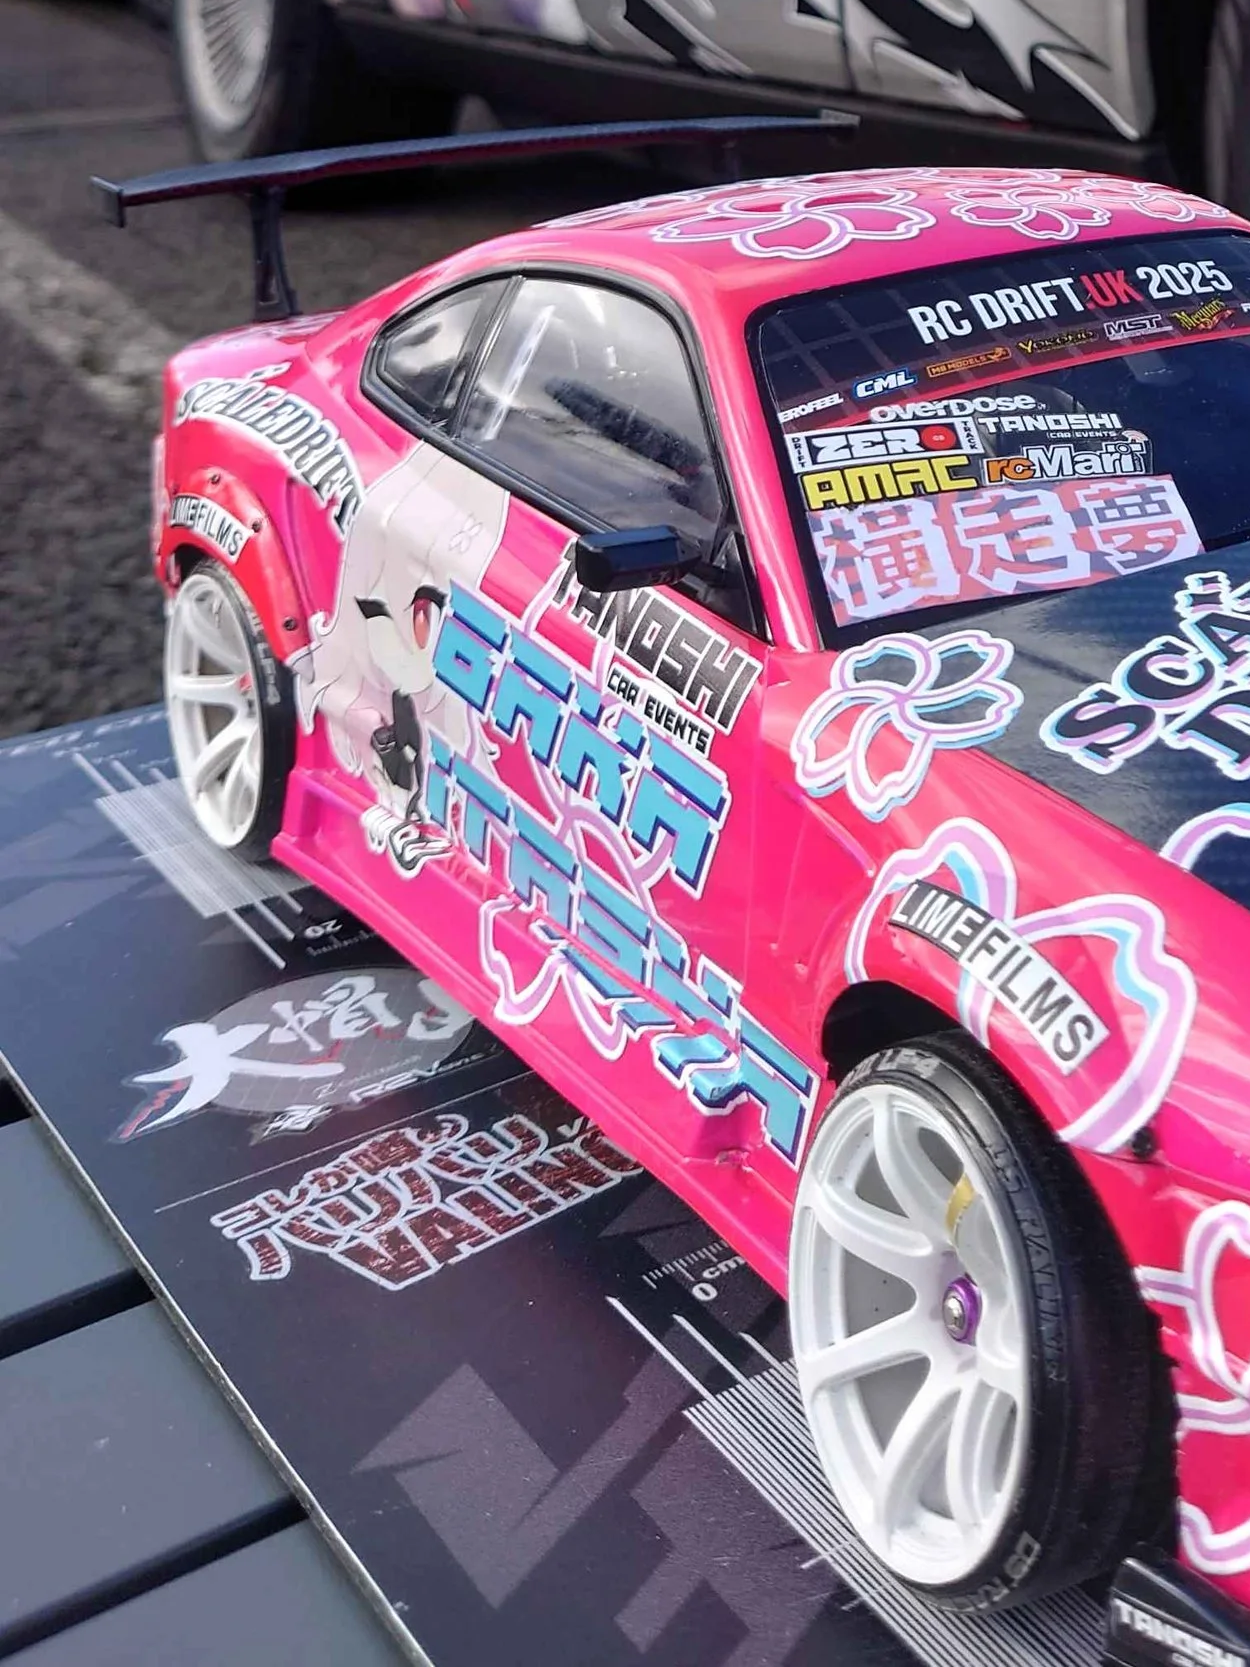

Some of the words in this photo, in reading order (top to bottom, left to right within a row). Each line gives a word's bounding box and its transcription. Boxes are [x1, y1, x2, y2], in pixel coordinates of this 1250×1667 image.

[906, 299, 973, 345] RC
[1136, 260, 1234, 300] 2025
[1107, 316, 1161, 337] MST
[855, 370, 916, 398] CML
[962, 420, 979, 451] TRACK
[978, 413, 1123, 433] TANOSHI
[791, 436, 806, 469] DRIFT
[802, 454, 979, 510] AMAC
[702, 1255, 746, 1279] cm
